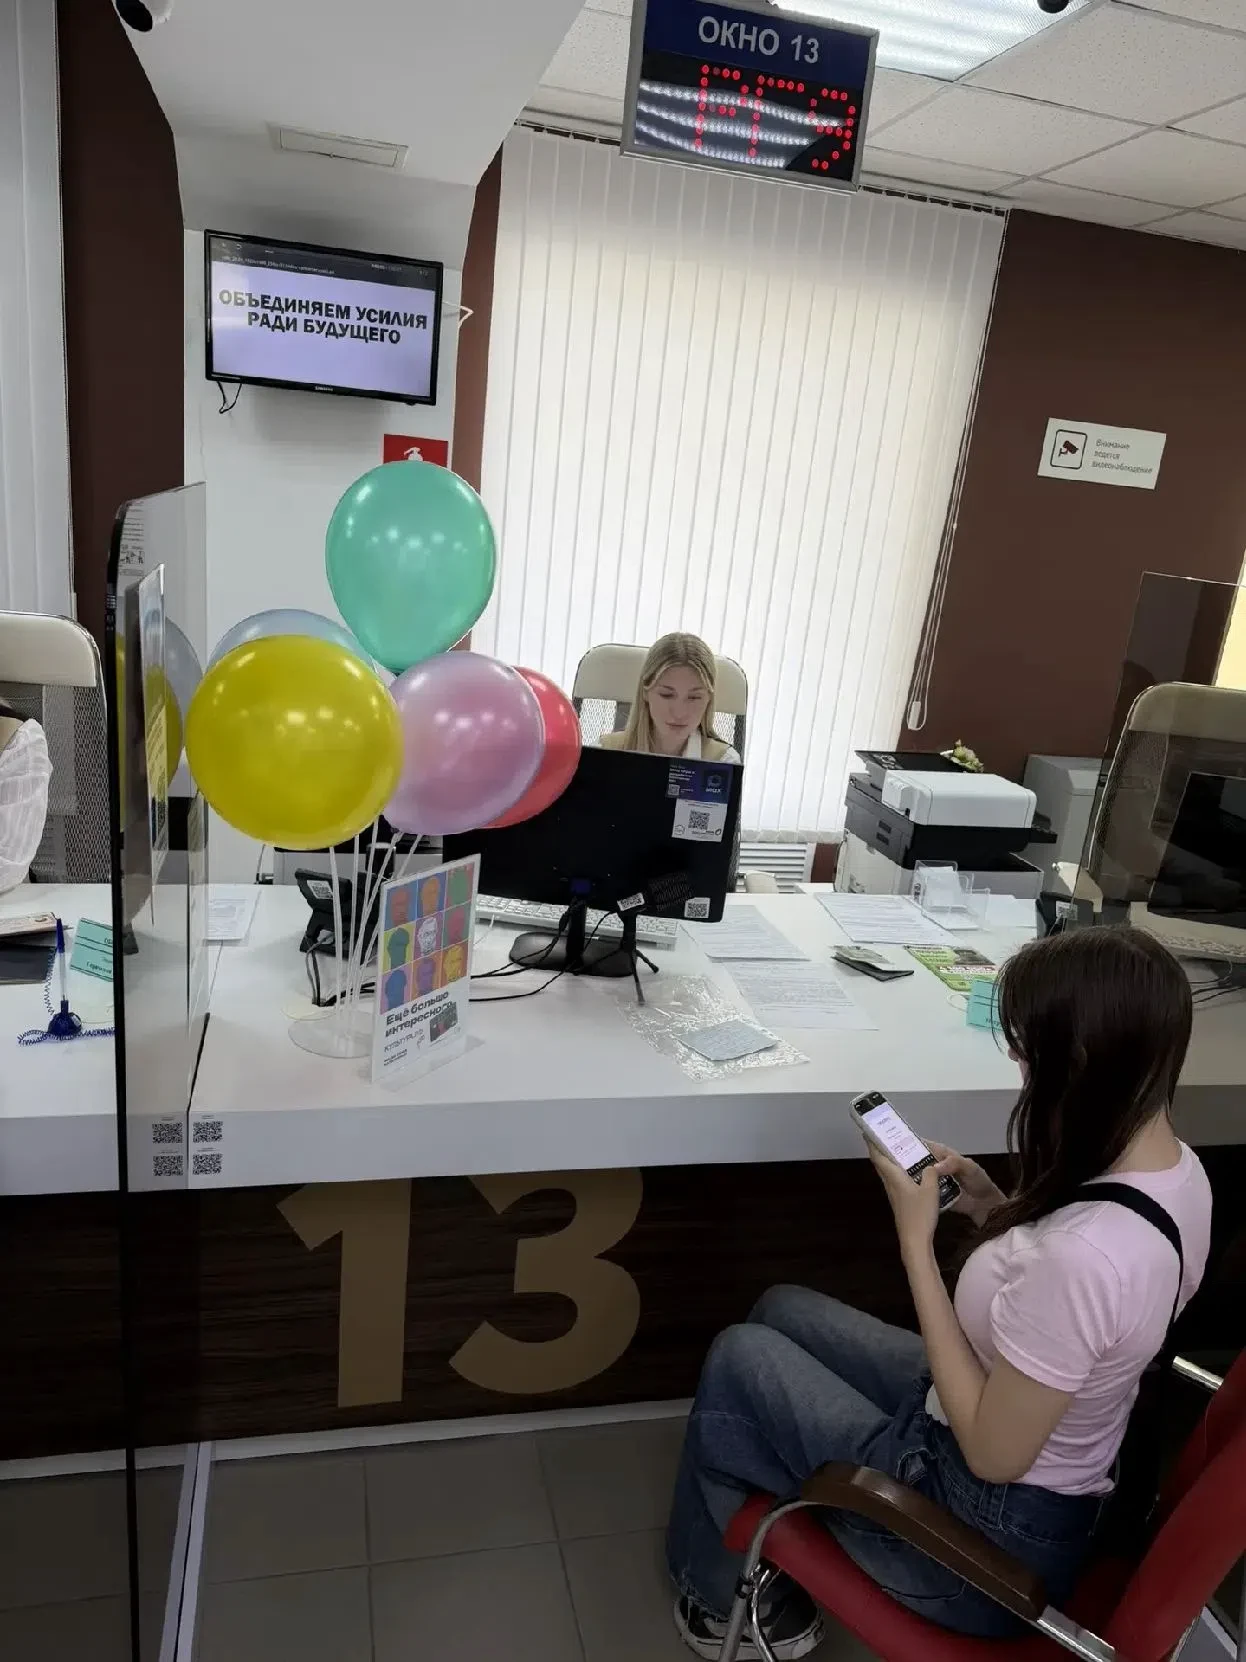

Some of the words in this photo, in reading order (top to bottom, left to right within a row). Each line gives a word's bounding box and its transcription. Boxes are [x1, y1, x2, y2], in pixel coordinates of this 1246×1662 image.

[698, 15, 780, 56] ОКНО
[790, 34, 819, 64] 13
[218, 289, 351, 320] ОБЪЕДИНЯЕМ
[356, 305, 428, 330] УСИЛИЯ
[247, 311, 298, 333] РАДИ
[303, 318, 401, 345] БУДУЩЕГО
[276, 1166, 643, 1408] 13
